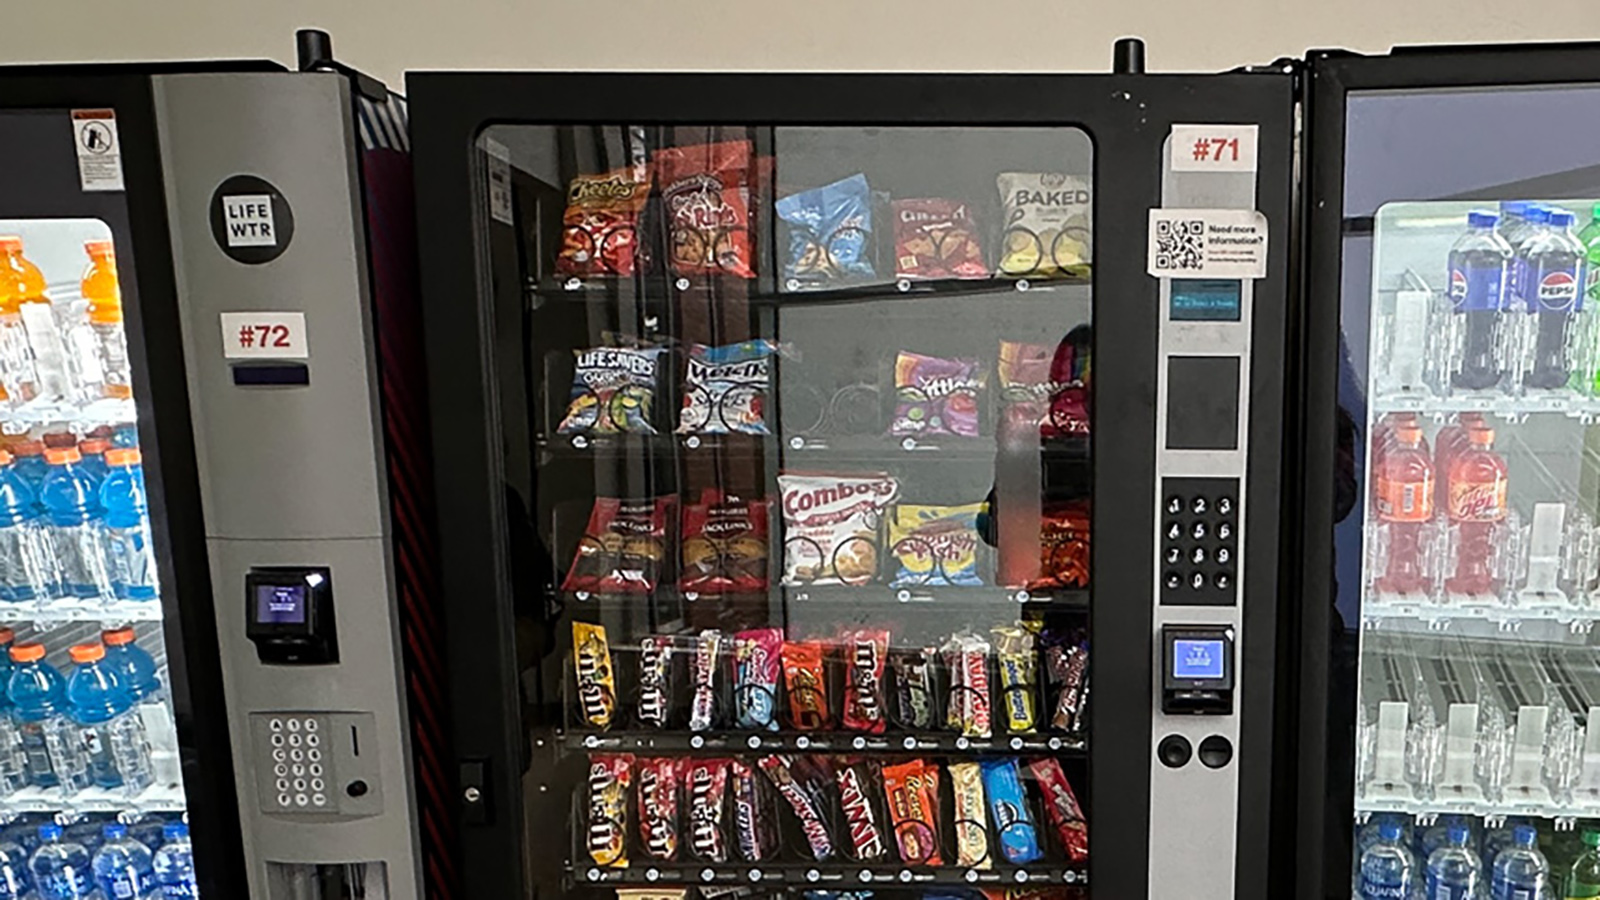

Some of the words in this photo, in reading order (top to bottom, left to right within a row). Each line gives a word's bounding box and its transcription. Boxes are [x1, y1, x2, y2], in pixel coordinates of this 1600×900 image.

[1192, 137, 1240, 162] #71
[1016, 189, 1090, 206] BAKED
[228, 203, 268, 219] LIFE
[230, 222, 272, 238] WTR
[238, 324, 291, 348] #72
[1168, 499, 1180, 513] 1
[1194, 499, 1206, 513] 2
[1220, 499, 1231, 513] 3
[1168, 524, 1179, 538] 4
[1194, 524, 1205, 538] 5
[1219, 524, 1230, 538] 6
[1168, 549, 1179, 563] 7
[1193, 549, 1204, 563] 8
[1218, 549, 1229, 563] 9
[1193, 573, 1202, 588] 0
